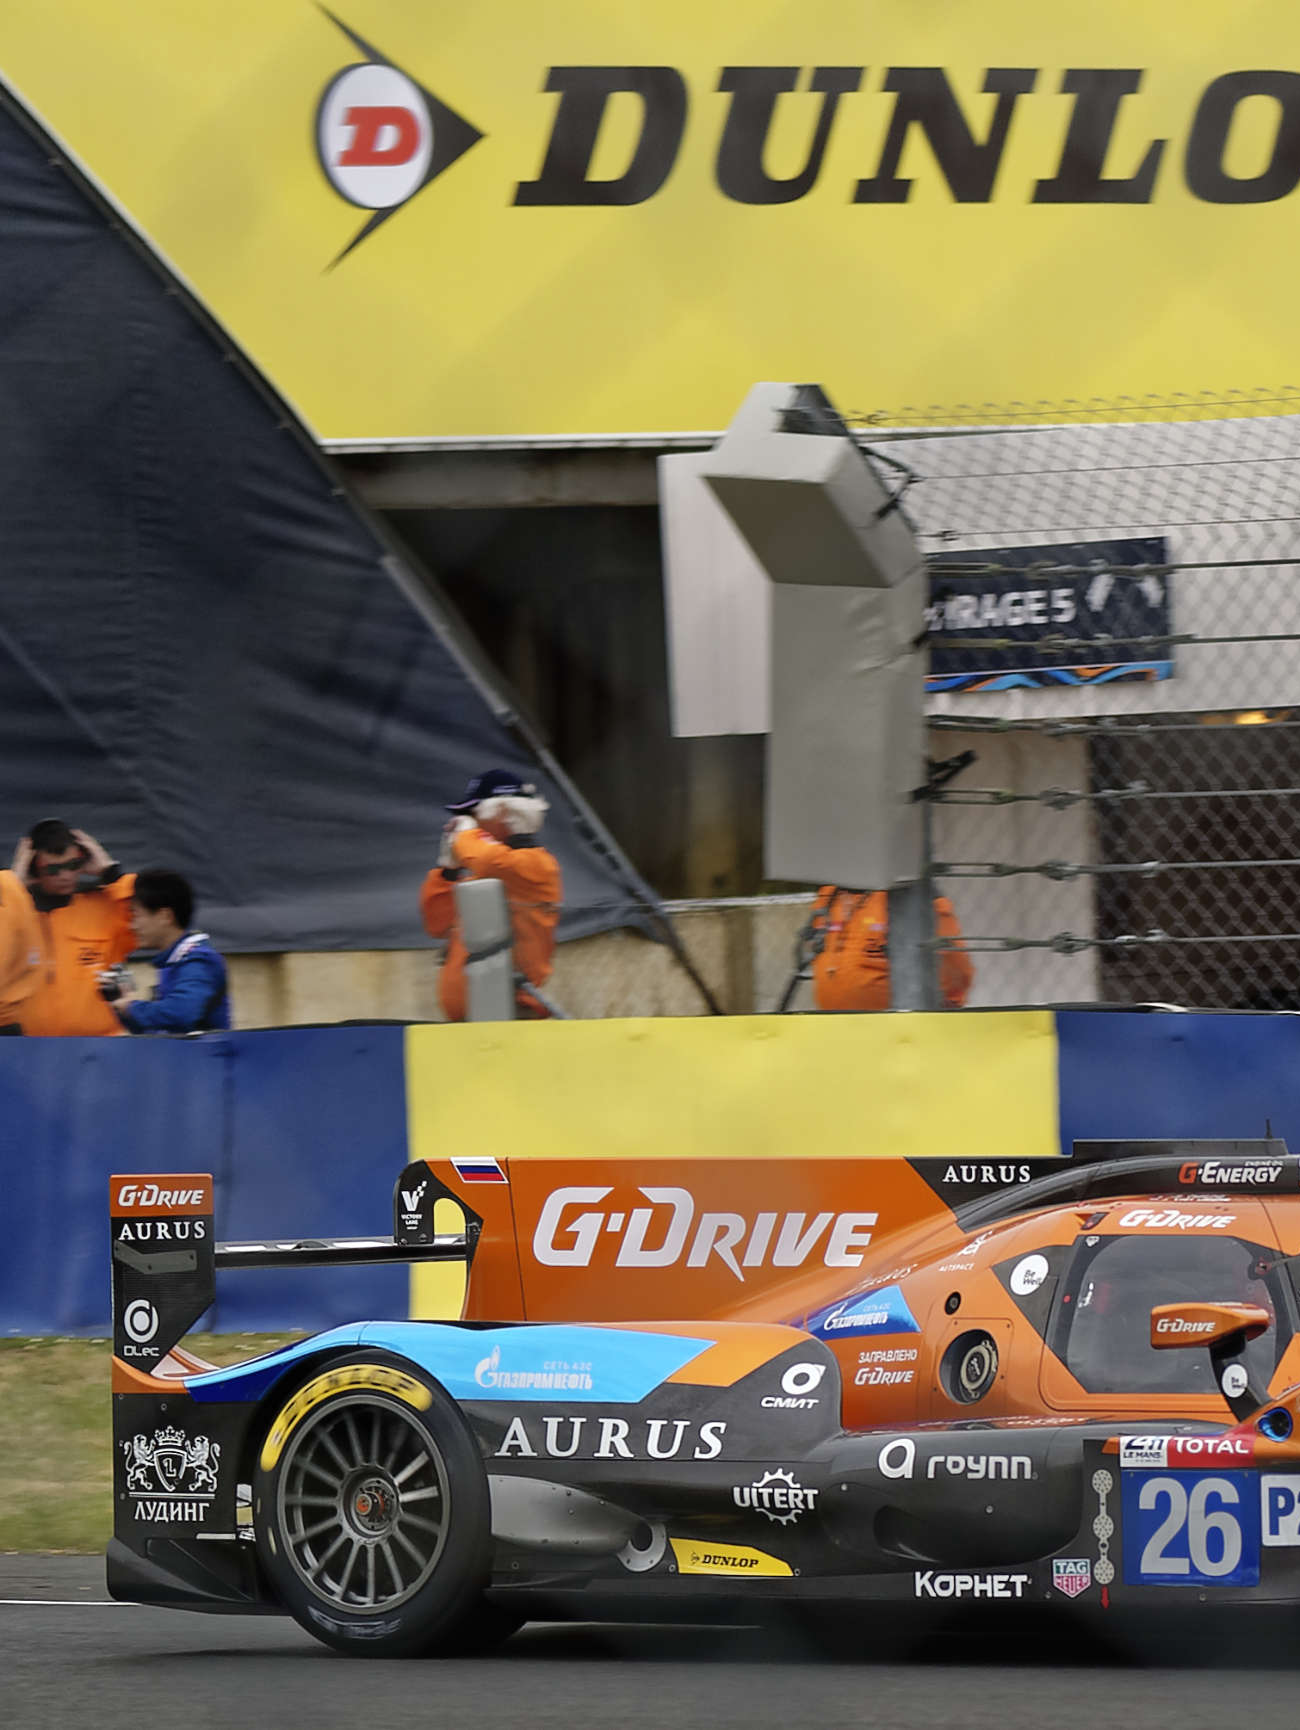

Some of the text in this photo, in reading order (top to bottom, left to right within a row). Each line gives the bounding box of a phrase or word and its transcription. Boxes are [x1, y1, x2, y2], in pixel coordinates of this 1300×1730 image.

[1051, 587, 1076, 623] 5
[941, 1164, 1032, 1183] AURUS
[1178, 1161, 1282, 1186] G-ENERGY
[117, 1184, 204, 1208] G-DRIVE
[1118, 1209, 1237, 1230] G-DRIVE
[118, 1221, 207, 1242] AURUS
[532, 1186, 879, 1283] G-DRIVE
[1156, 1318, 1217, 1333] G-DRIVE
[858, 1348, 918, 1364] ЗАПРАВЛЕНО
[854, 1367, 915, 1388] G-DRIVE
[493, 1416, 728, 1460] AURUS
[1172, 1436, 1250, 1454] TOTAL
[1123, 1451, 1161, 1459] LE MANS
[732, 1486, 819, 1511] UITERT
[134, 1500, 210, 1523] ЛУДИНГ
[1137, 1476, 1243, 1577] 26
[702, 1554, 759, 1568] DUNLOP
[1056, 1561, 1088, 1574] TAG
